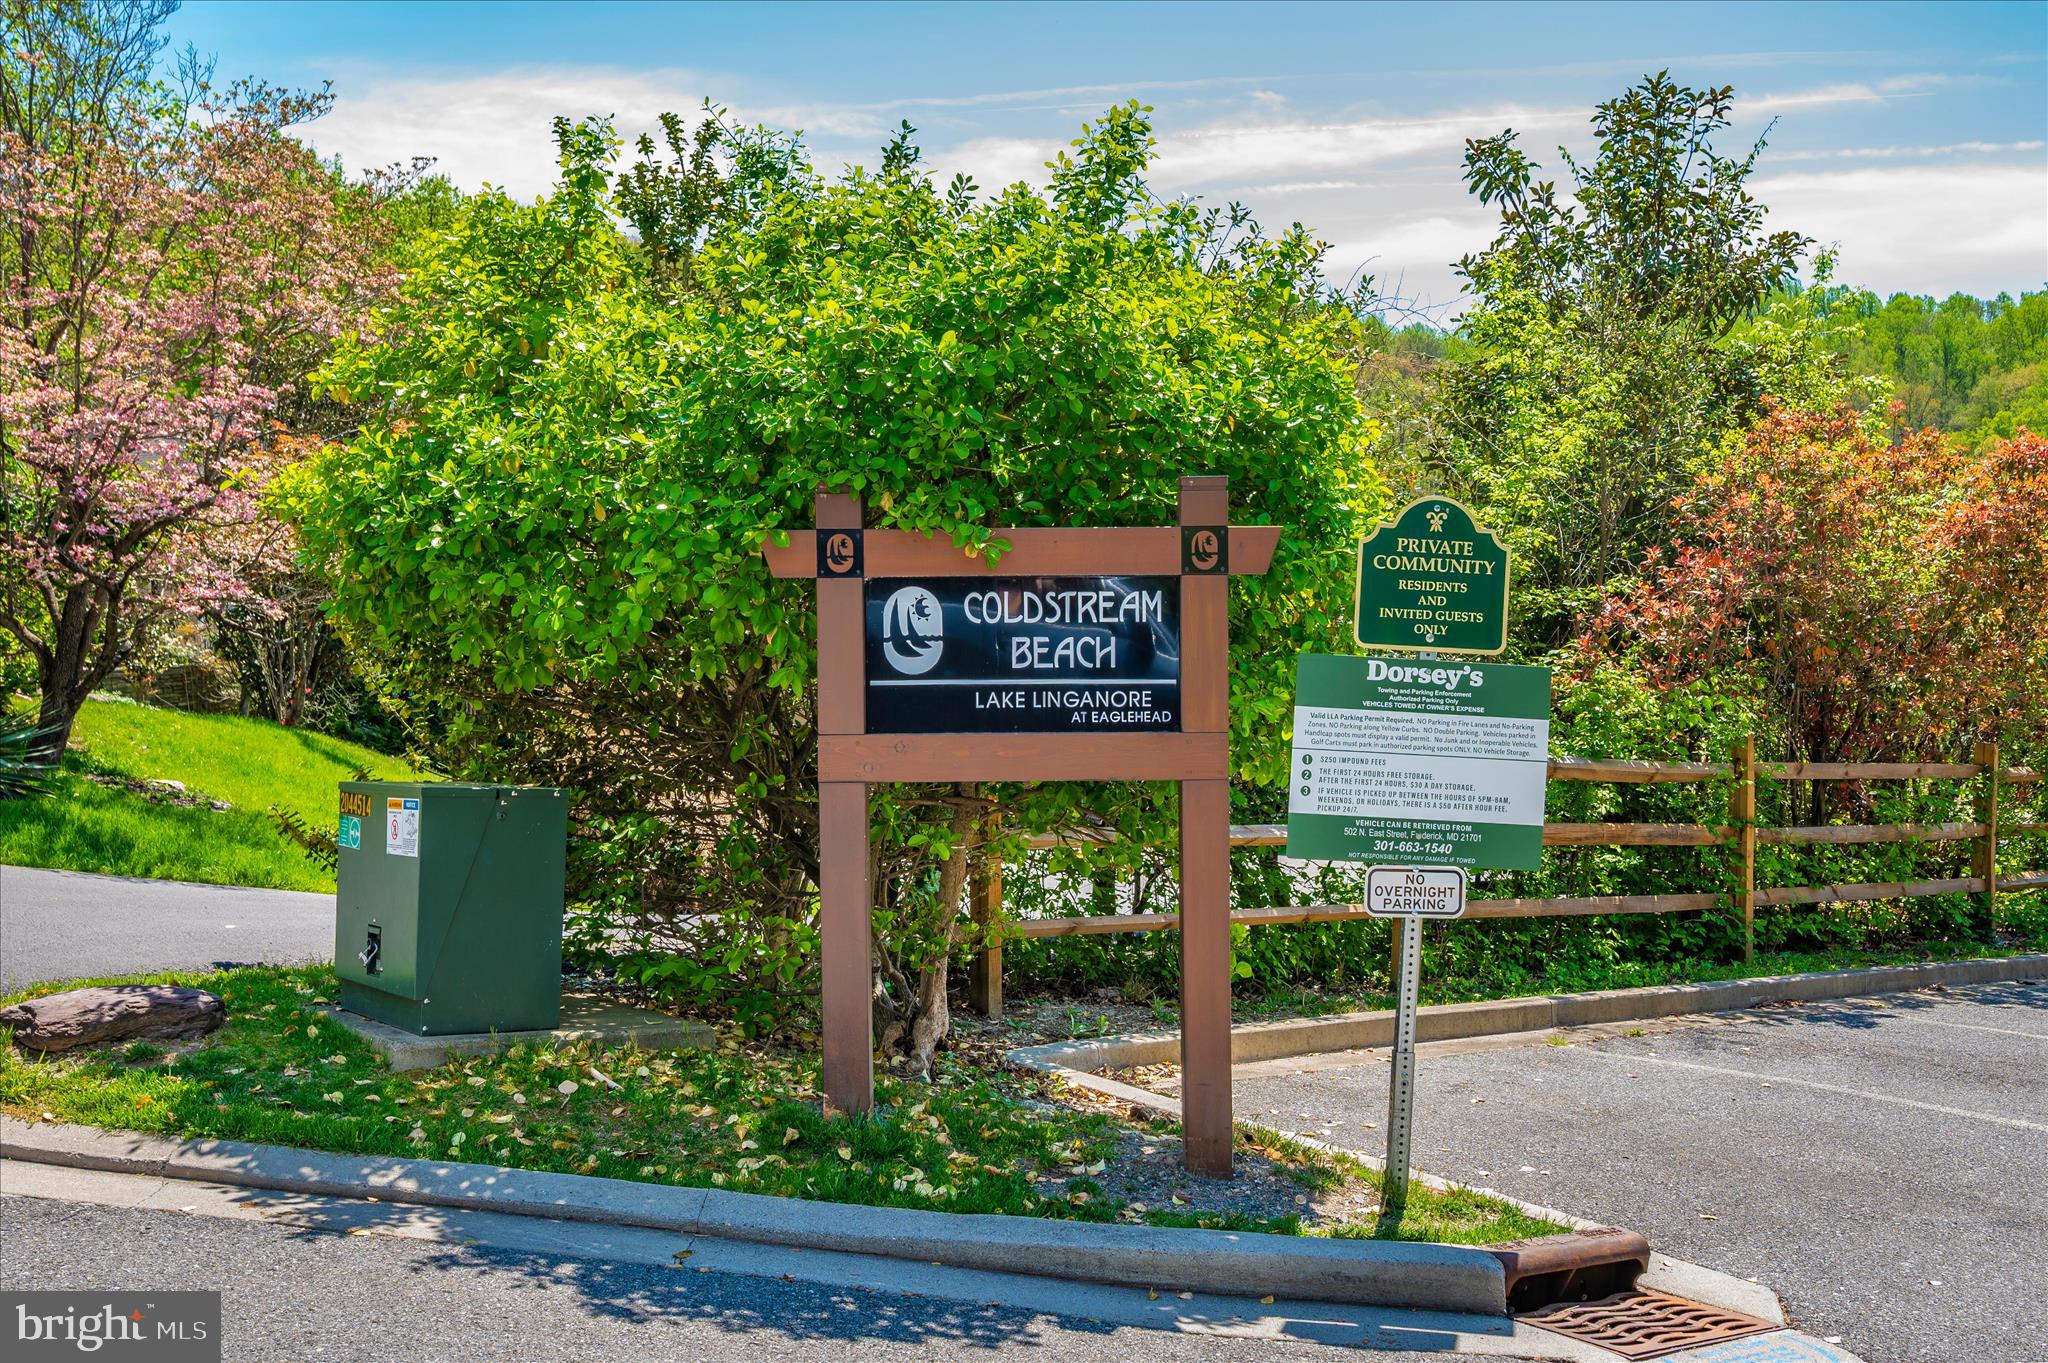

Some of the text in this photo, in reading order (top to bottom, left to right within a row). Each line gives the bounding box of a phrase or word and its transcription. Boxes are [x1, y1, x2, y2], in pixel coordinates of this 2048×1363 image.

[1397, 538, 1473, 555] PRIVATE
[1373, 555, 1495, 575] COMMUNITY
[1399, 580, 1467, 592] RESIDENTS
[963, 590, 1162, 623] COLDSTREAM
[1418, 596, 1446, 606] AND
[1380, 608, 1483, 622] INVITED GUESTS
[1414, 624, 1448, 635] ONLY
[1012, 636, 1116, 668] BEACH
[1367, 660, 1483, 690] Dorsey's
[975, 691, 1152, 708] LAKE LINGANORE
[1071, 711, 1171, 723] AT EAGLEHEAD
[1340, 714, 1363, 722] Parking
[1428, 719, 1450, 727] Parking
[1502, 723, 1534, 731] No-Parking
[341, 792, 371, 816] 2044514
[1369, 829, 1384, 837] East
[1374, 840, 1452, 854] 301-663-1540
[1406, 875, 1424, 885] NO
[1375, 886, 1455, 897] OVERNIGHT
[1384, 899, 1445, 910] PARKING
